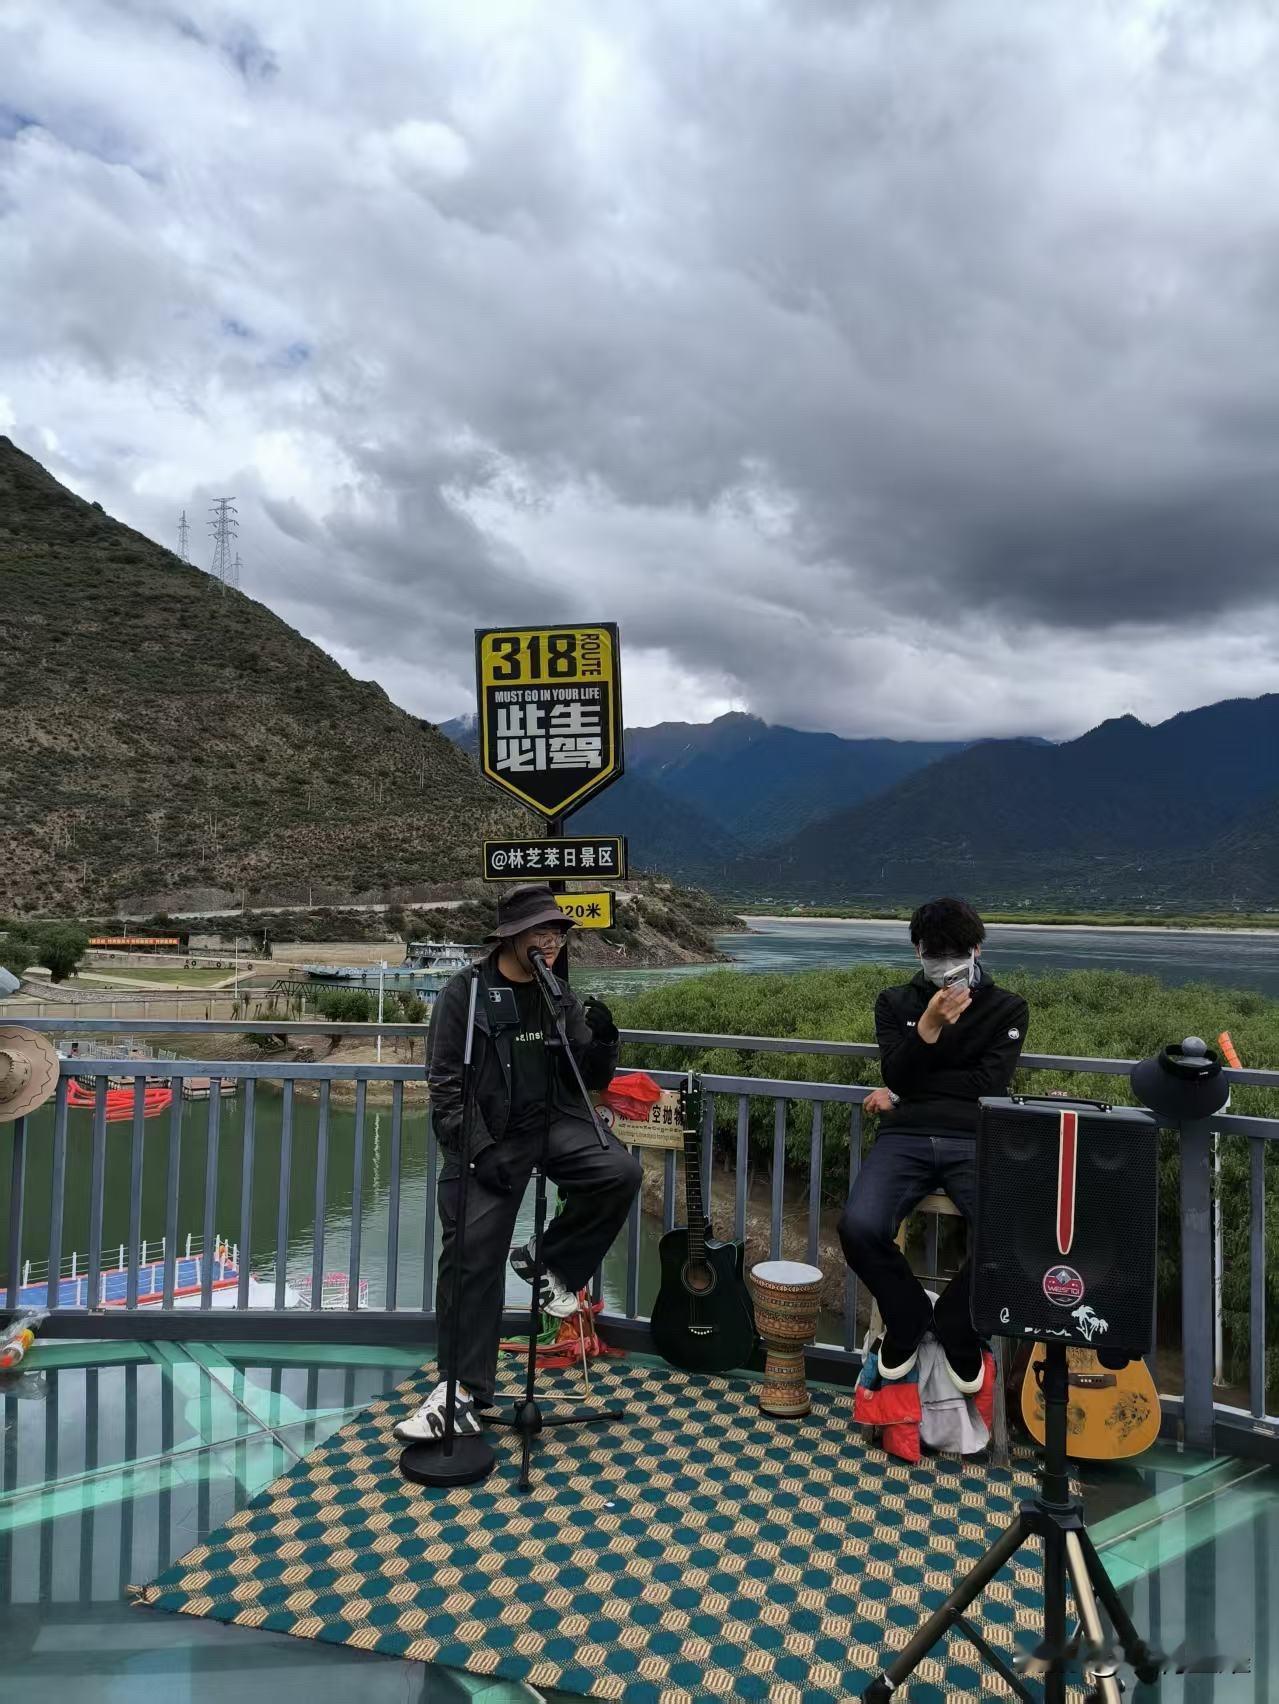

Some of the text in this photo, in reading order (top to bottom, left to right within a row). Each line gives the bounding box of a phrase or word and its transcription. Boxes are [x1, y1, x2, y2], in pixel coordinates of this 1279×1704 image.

[492, 634, 577, 680] 318
[581, 634, 601, 676] ROUTE
[495, 687, 600, 702] MUST GO IN YOUR LIFE
[496, 703, 601, 737] 此生
[496, 737, 602, 771] 必驾
